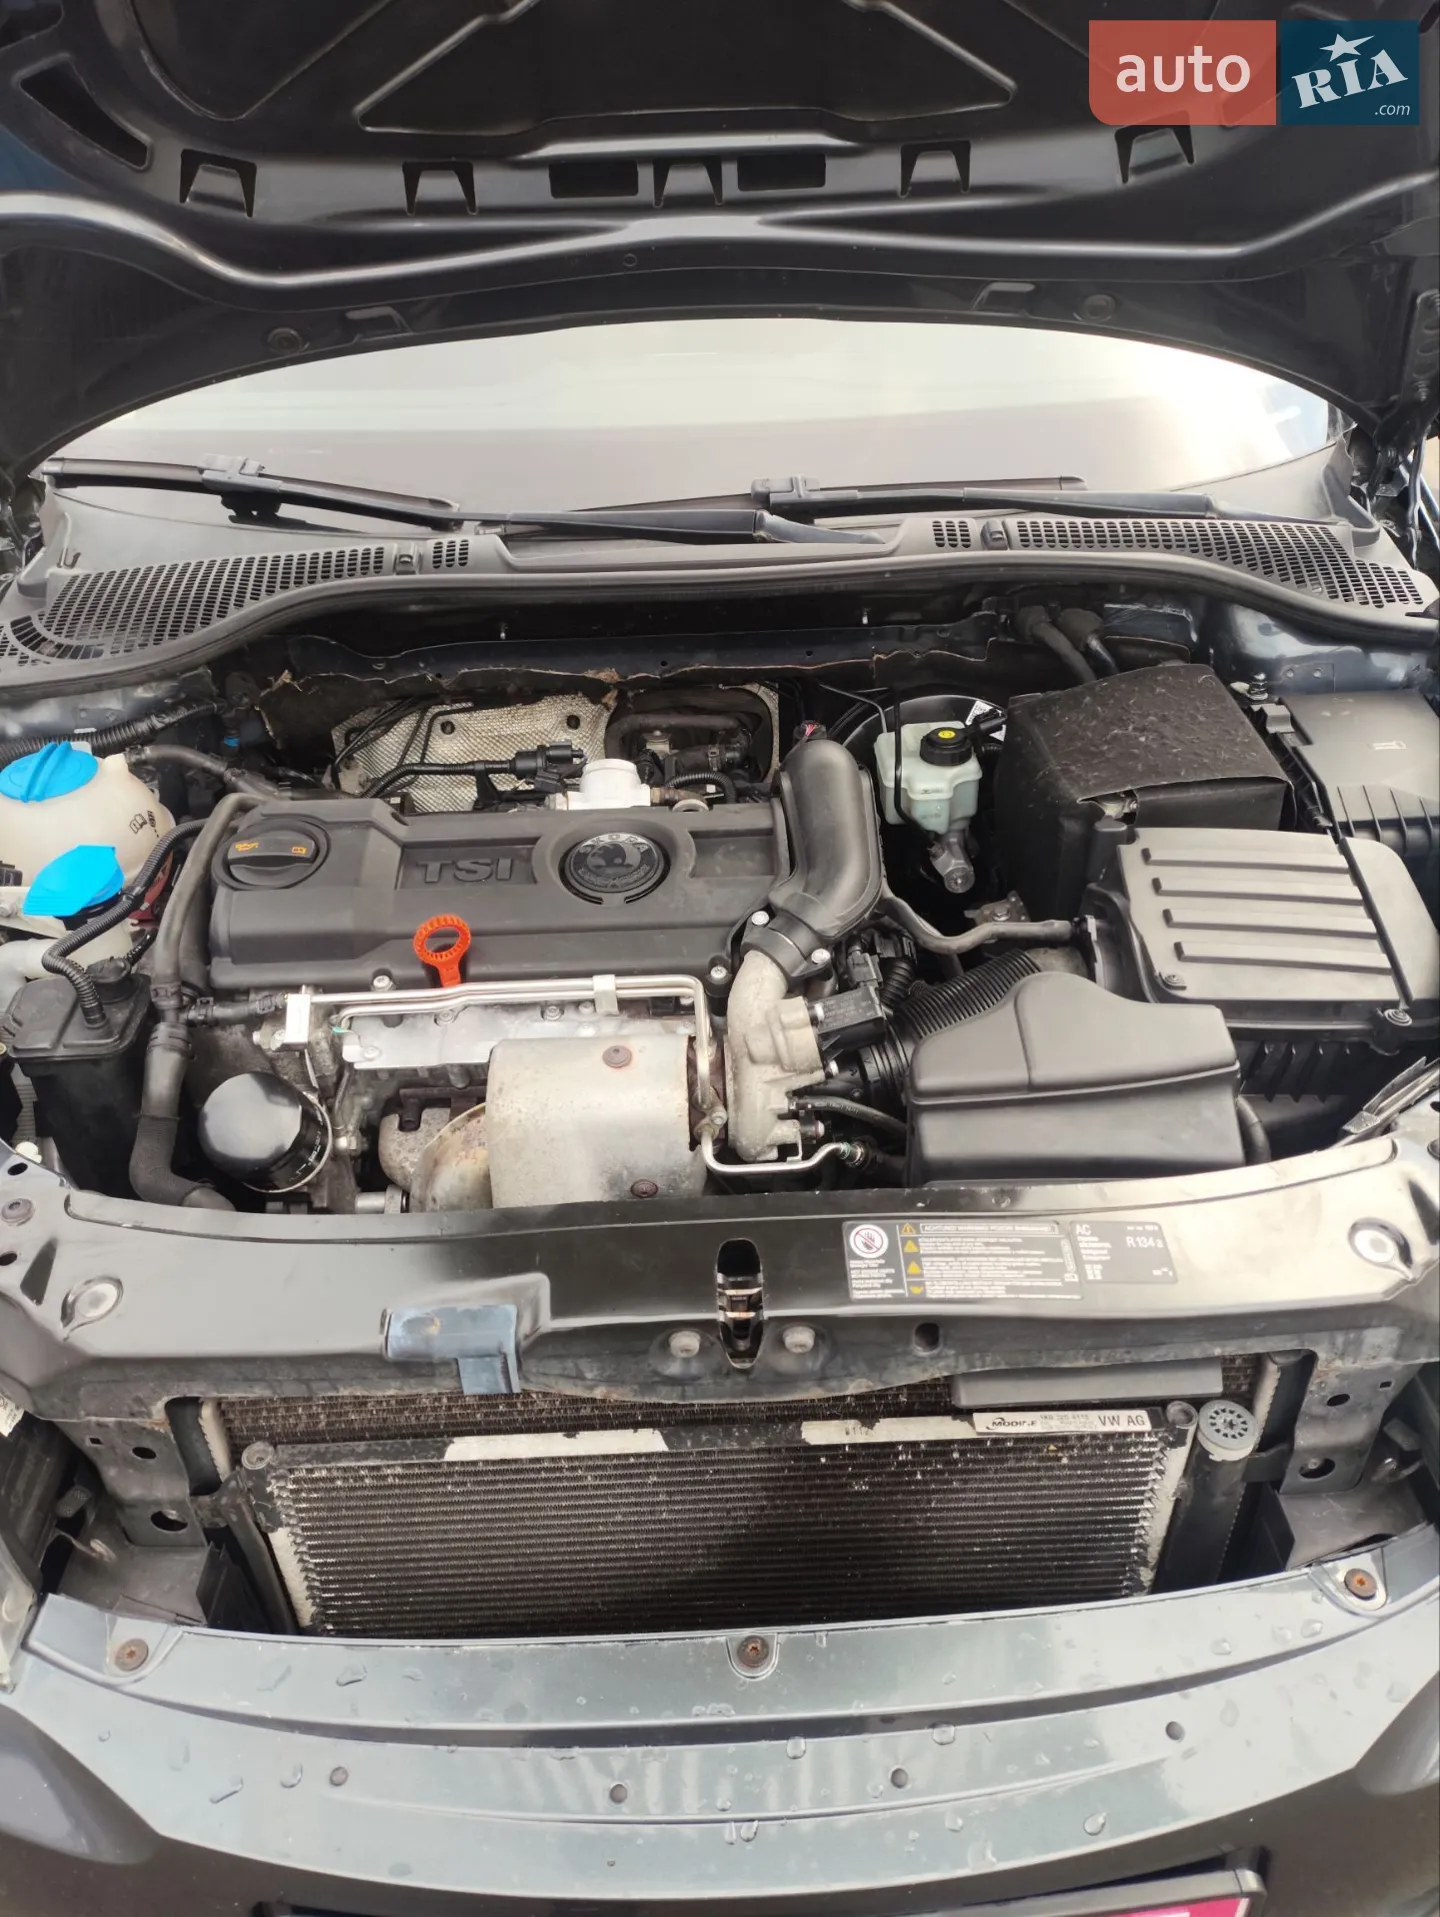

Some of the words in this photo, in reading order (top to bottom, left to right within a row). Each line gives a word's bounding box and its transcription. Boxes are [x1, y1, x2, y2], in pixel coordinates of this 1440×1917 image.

[416, 858, 514, 884] TSI
[1075, 1224, 1092, 1236] AC
[1098, 1414, 1121, 1427] VW
[1126, 1414, 1146, 1426] AG
